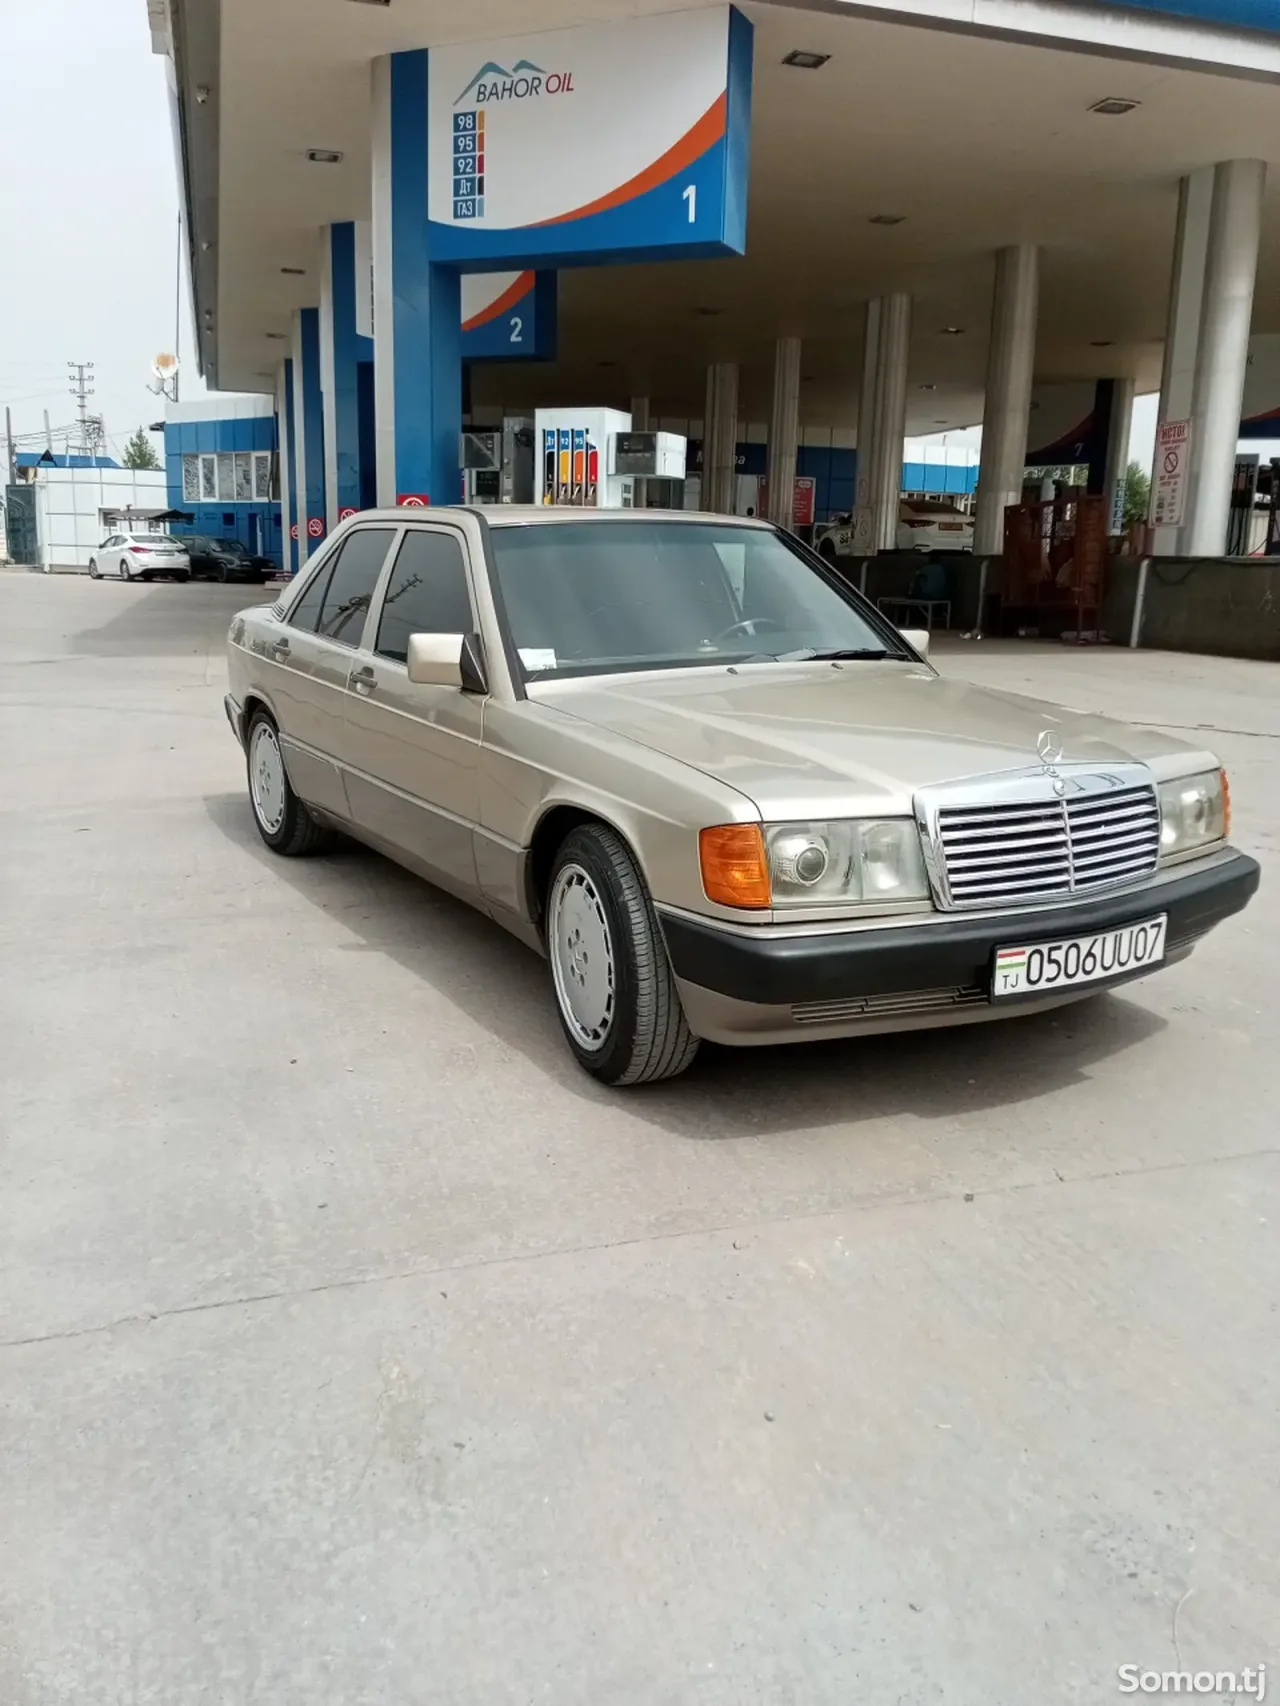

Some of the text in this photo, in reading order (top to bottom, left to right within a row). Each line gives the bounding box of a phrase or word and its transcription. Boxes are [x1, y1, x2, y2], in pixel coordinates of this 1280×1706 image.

[476, 73, 574, 103] BAHOR OIL
[457, 116, 473, 129] 98
[457, 137, 473, 151] 95
[457, 159, 473, 173] 92
[457, 201, 473, 217] ГАЗ
[682, 185, 697, 223] 1
[510, 317, 523, 342] 2
[1002, 922, 1163, 989] TJ 0506UU07
